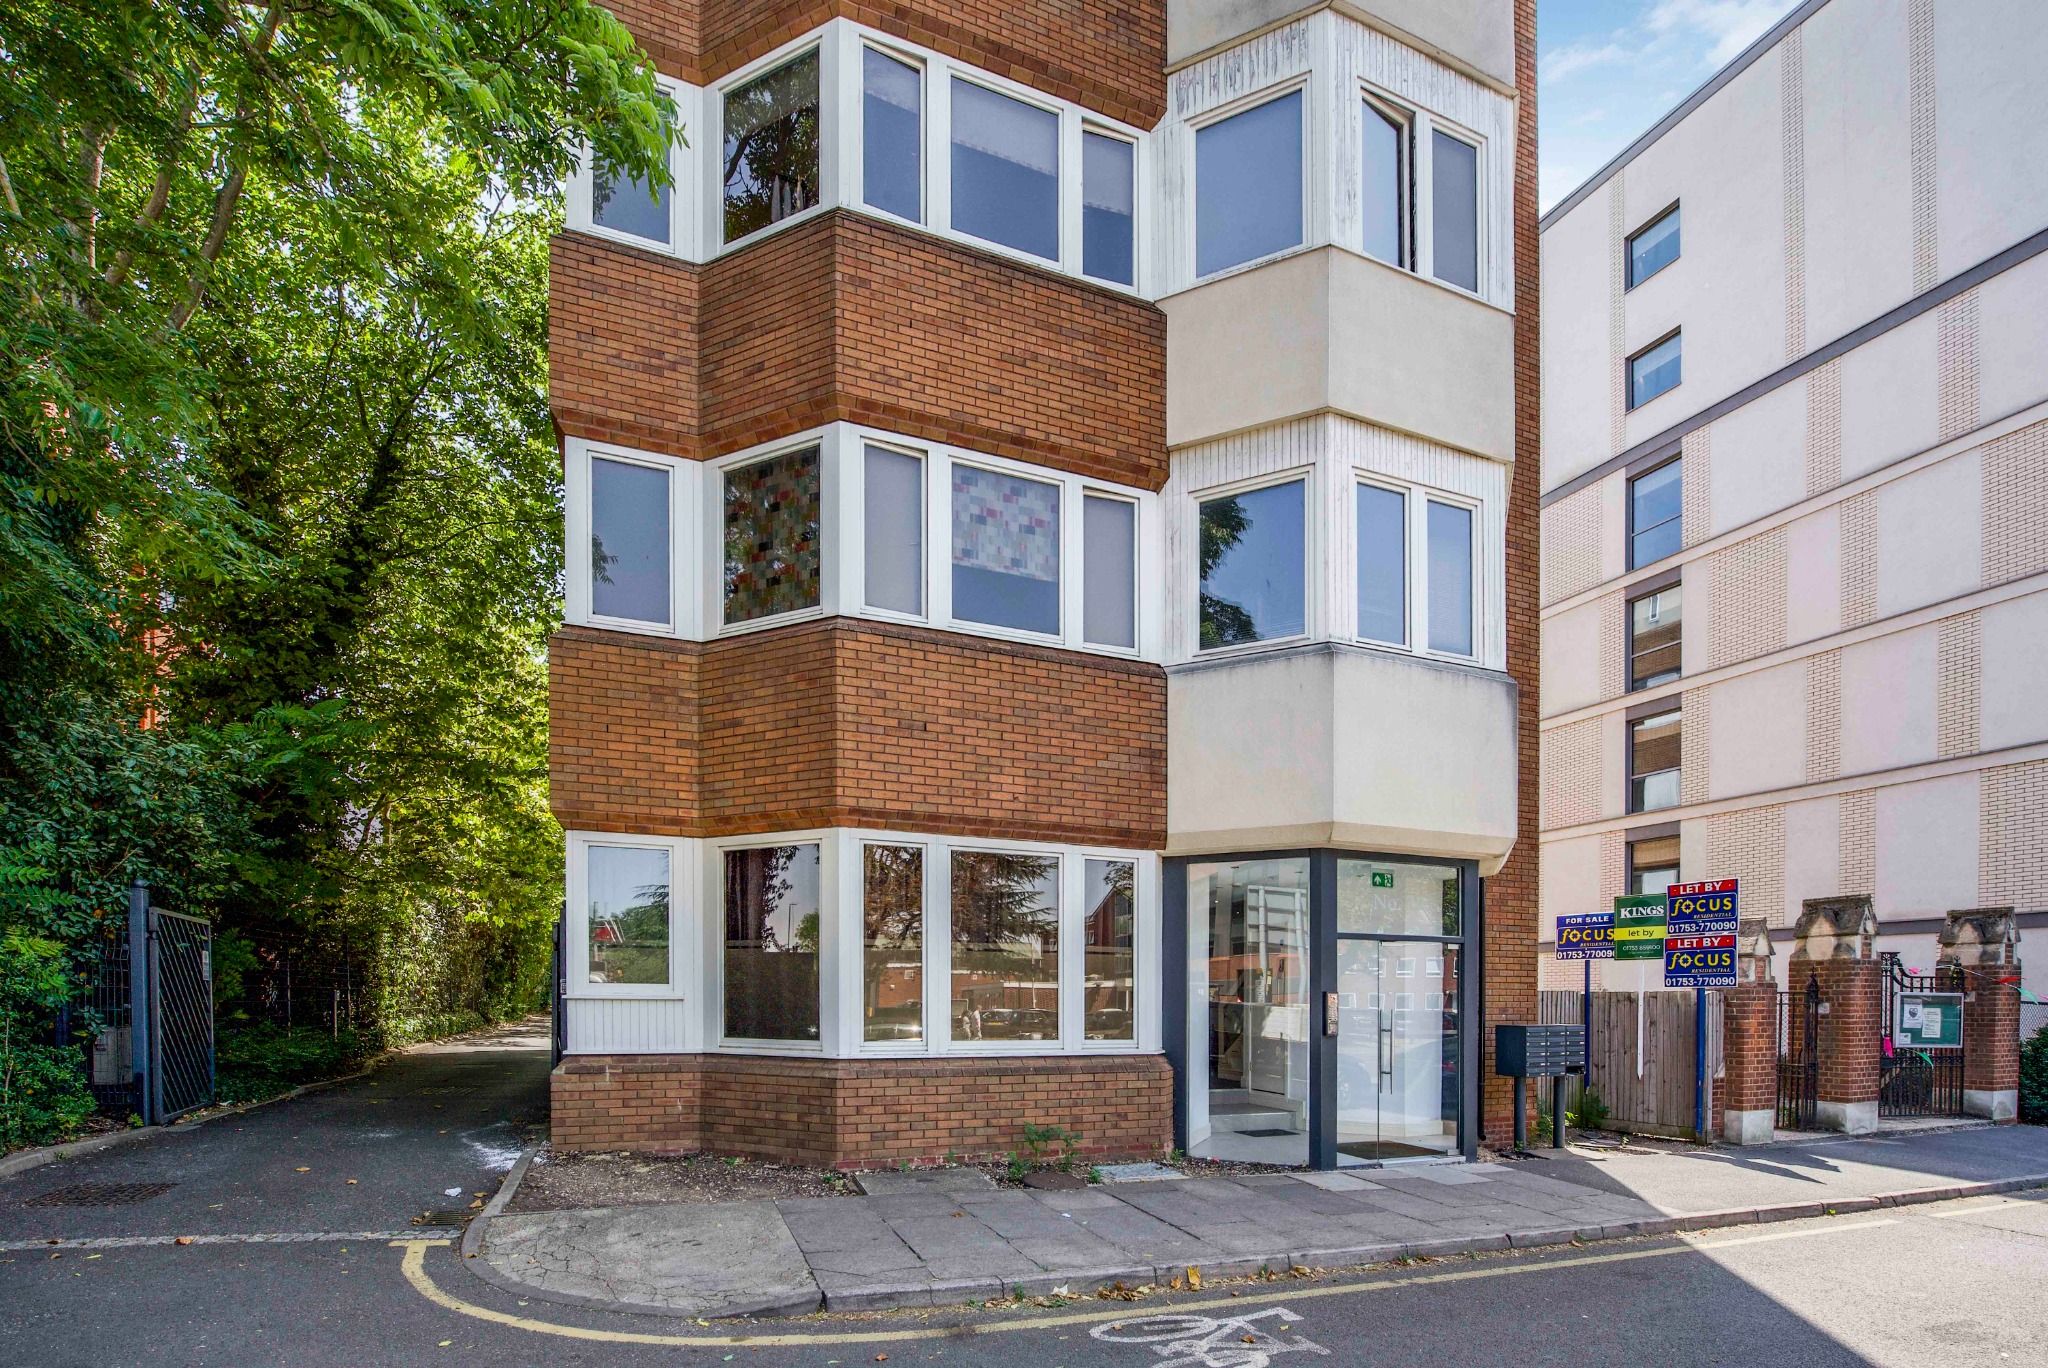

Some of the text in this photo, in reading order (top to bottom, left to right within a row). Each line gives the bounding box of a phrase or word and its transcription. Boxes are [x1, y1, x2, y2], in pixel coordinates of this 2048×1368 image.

[1680, 881, 1723, 895] LET BY
[1620, 905, 1665, 919] KINGS
[1565, 915, 1610, 925] FOR SALE
[1669, 921, 1737, 933] 01753-770090
[1628, 929, 1655, 938] let by
[1677, 937, 1721, 949] LET BY
[1665, 976, 1736, 987] 01753-770090
